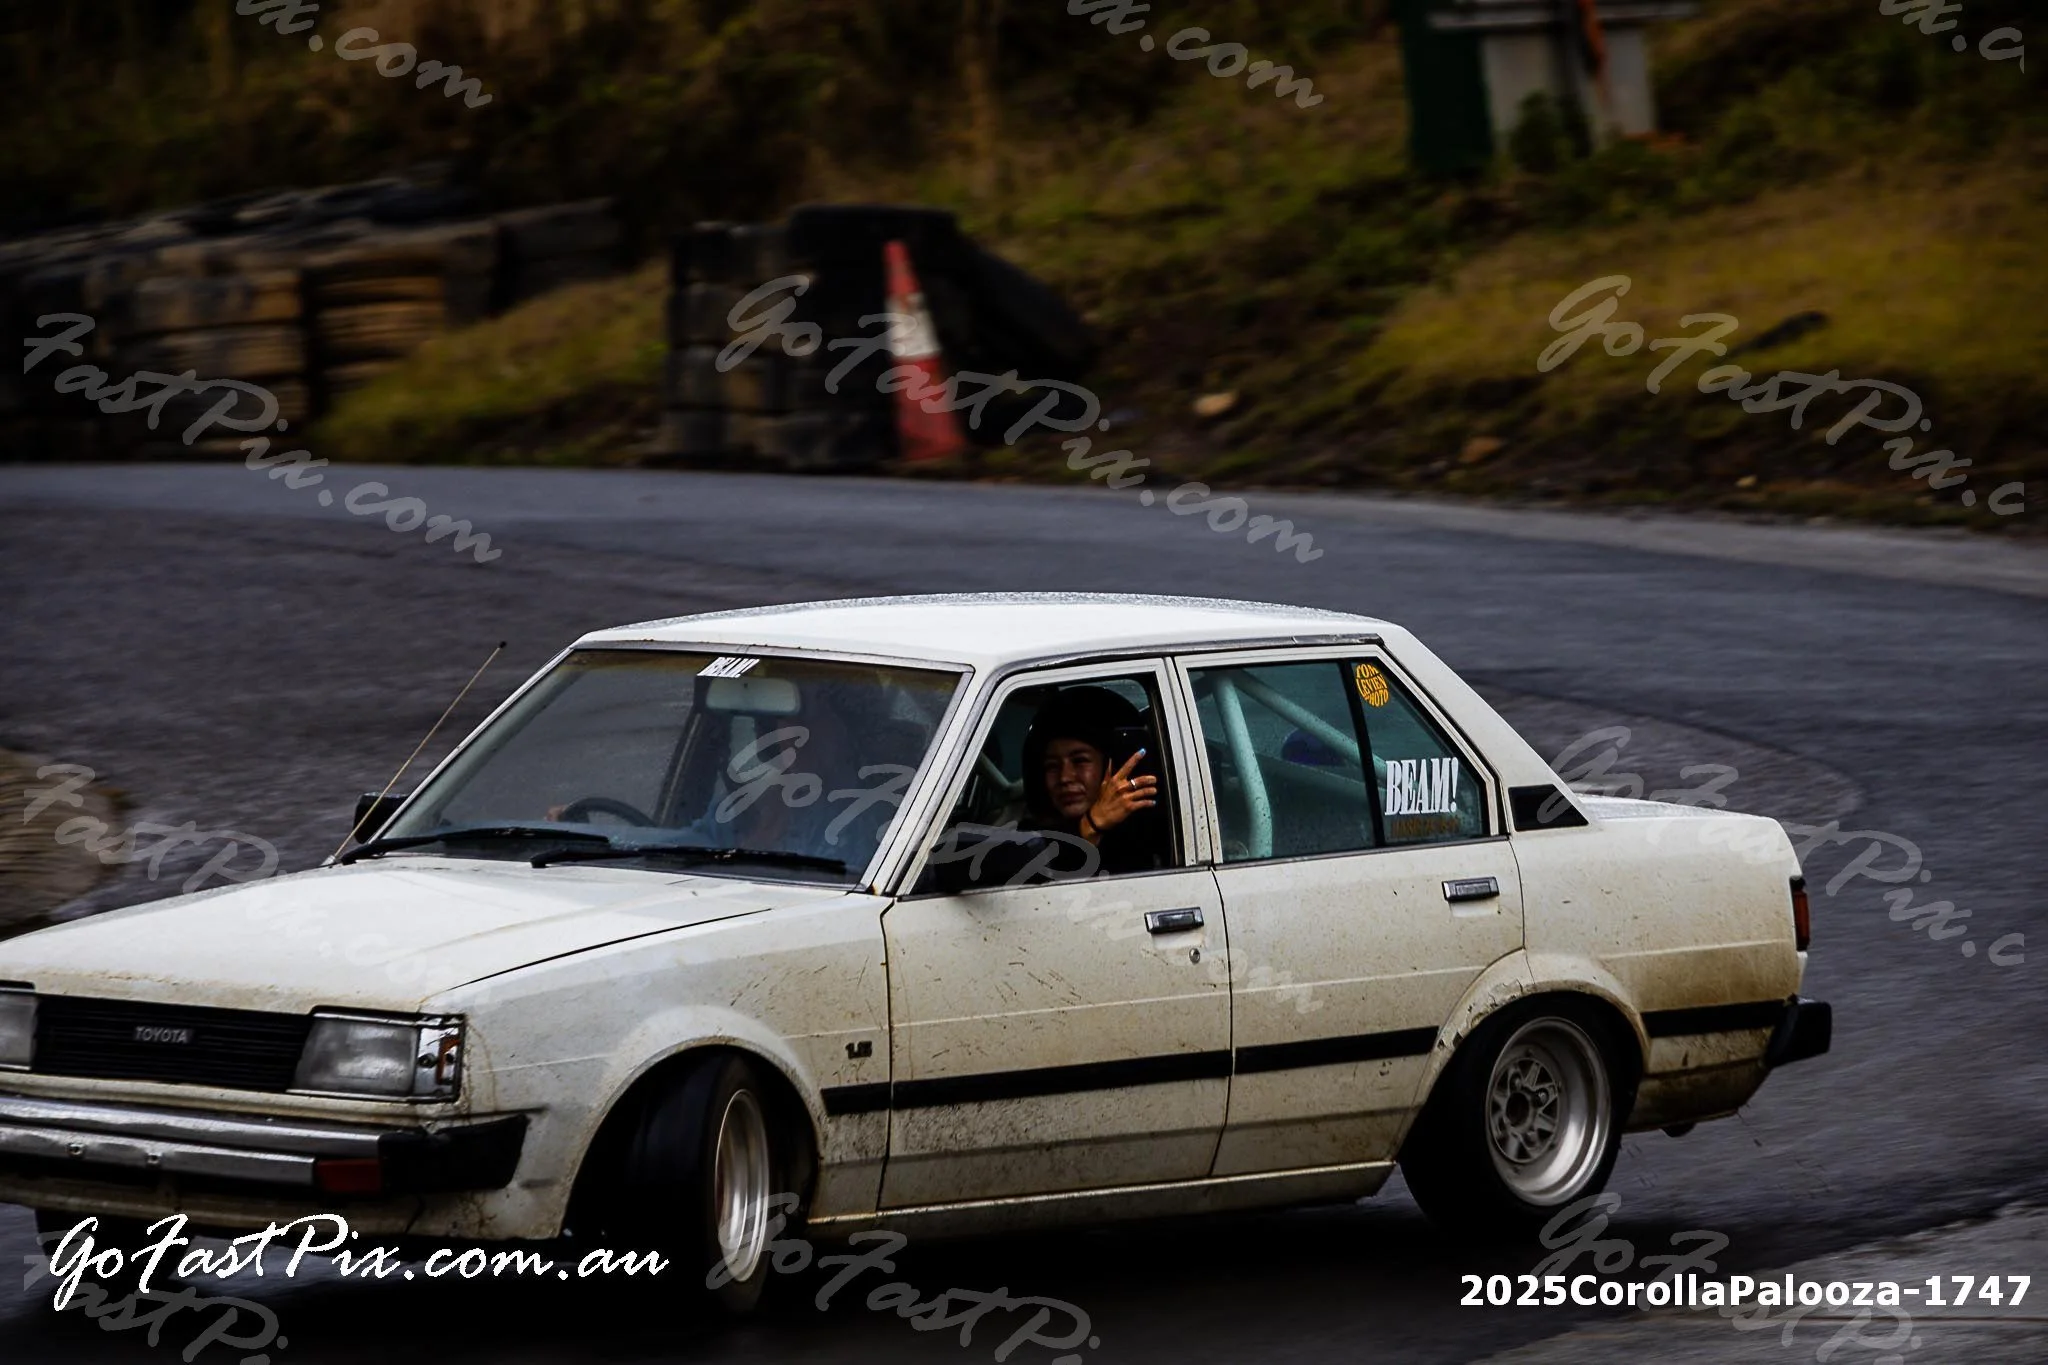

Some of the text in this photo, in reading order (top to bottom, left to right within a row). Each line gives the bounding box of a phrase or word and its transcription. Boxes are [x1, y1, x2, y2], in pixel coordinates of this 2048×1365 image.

[1356, 664, 1379, 678] TOM
[1384, 757, 1459, 816] BEAM!
[134, 1026, 189, 1044] TOYOTA
